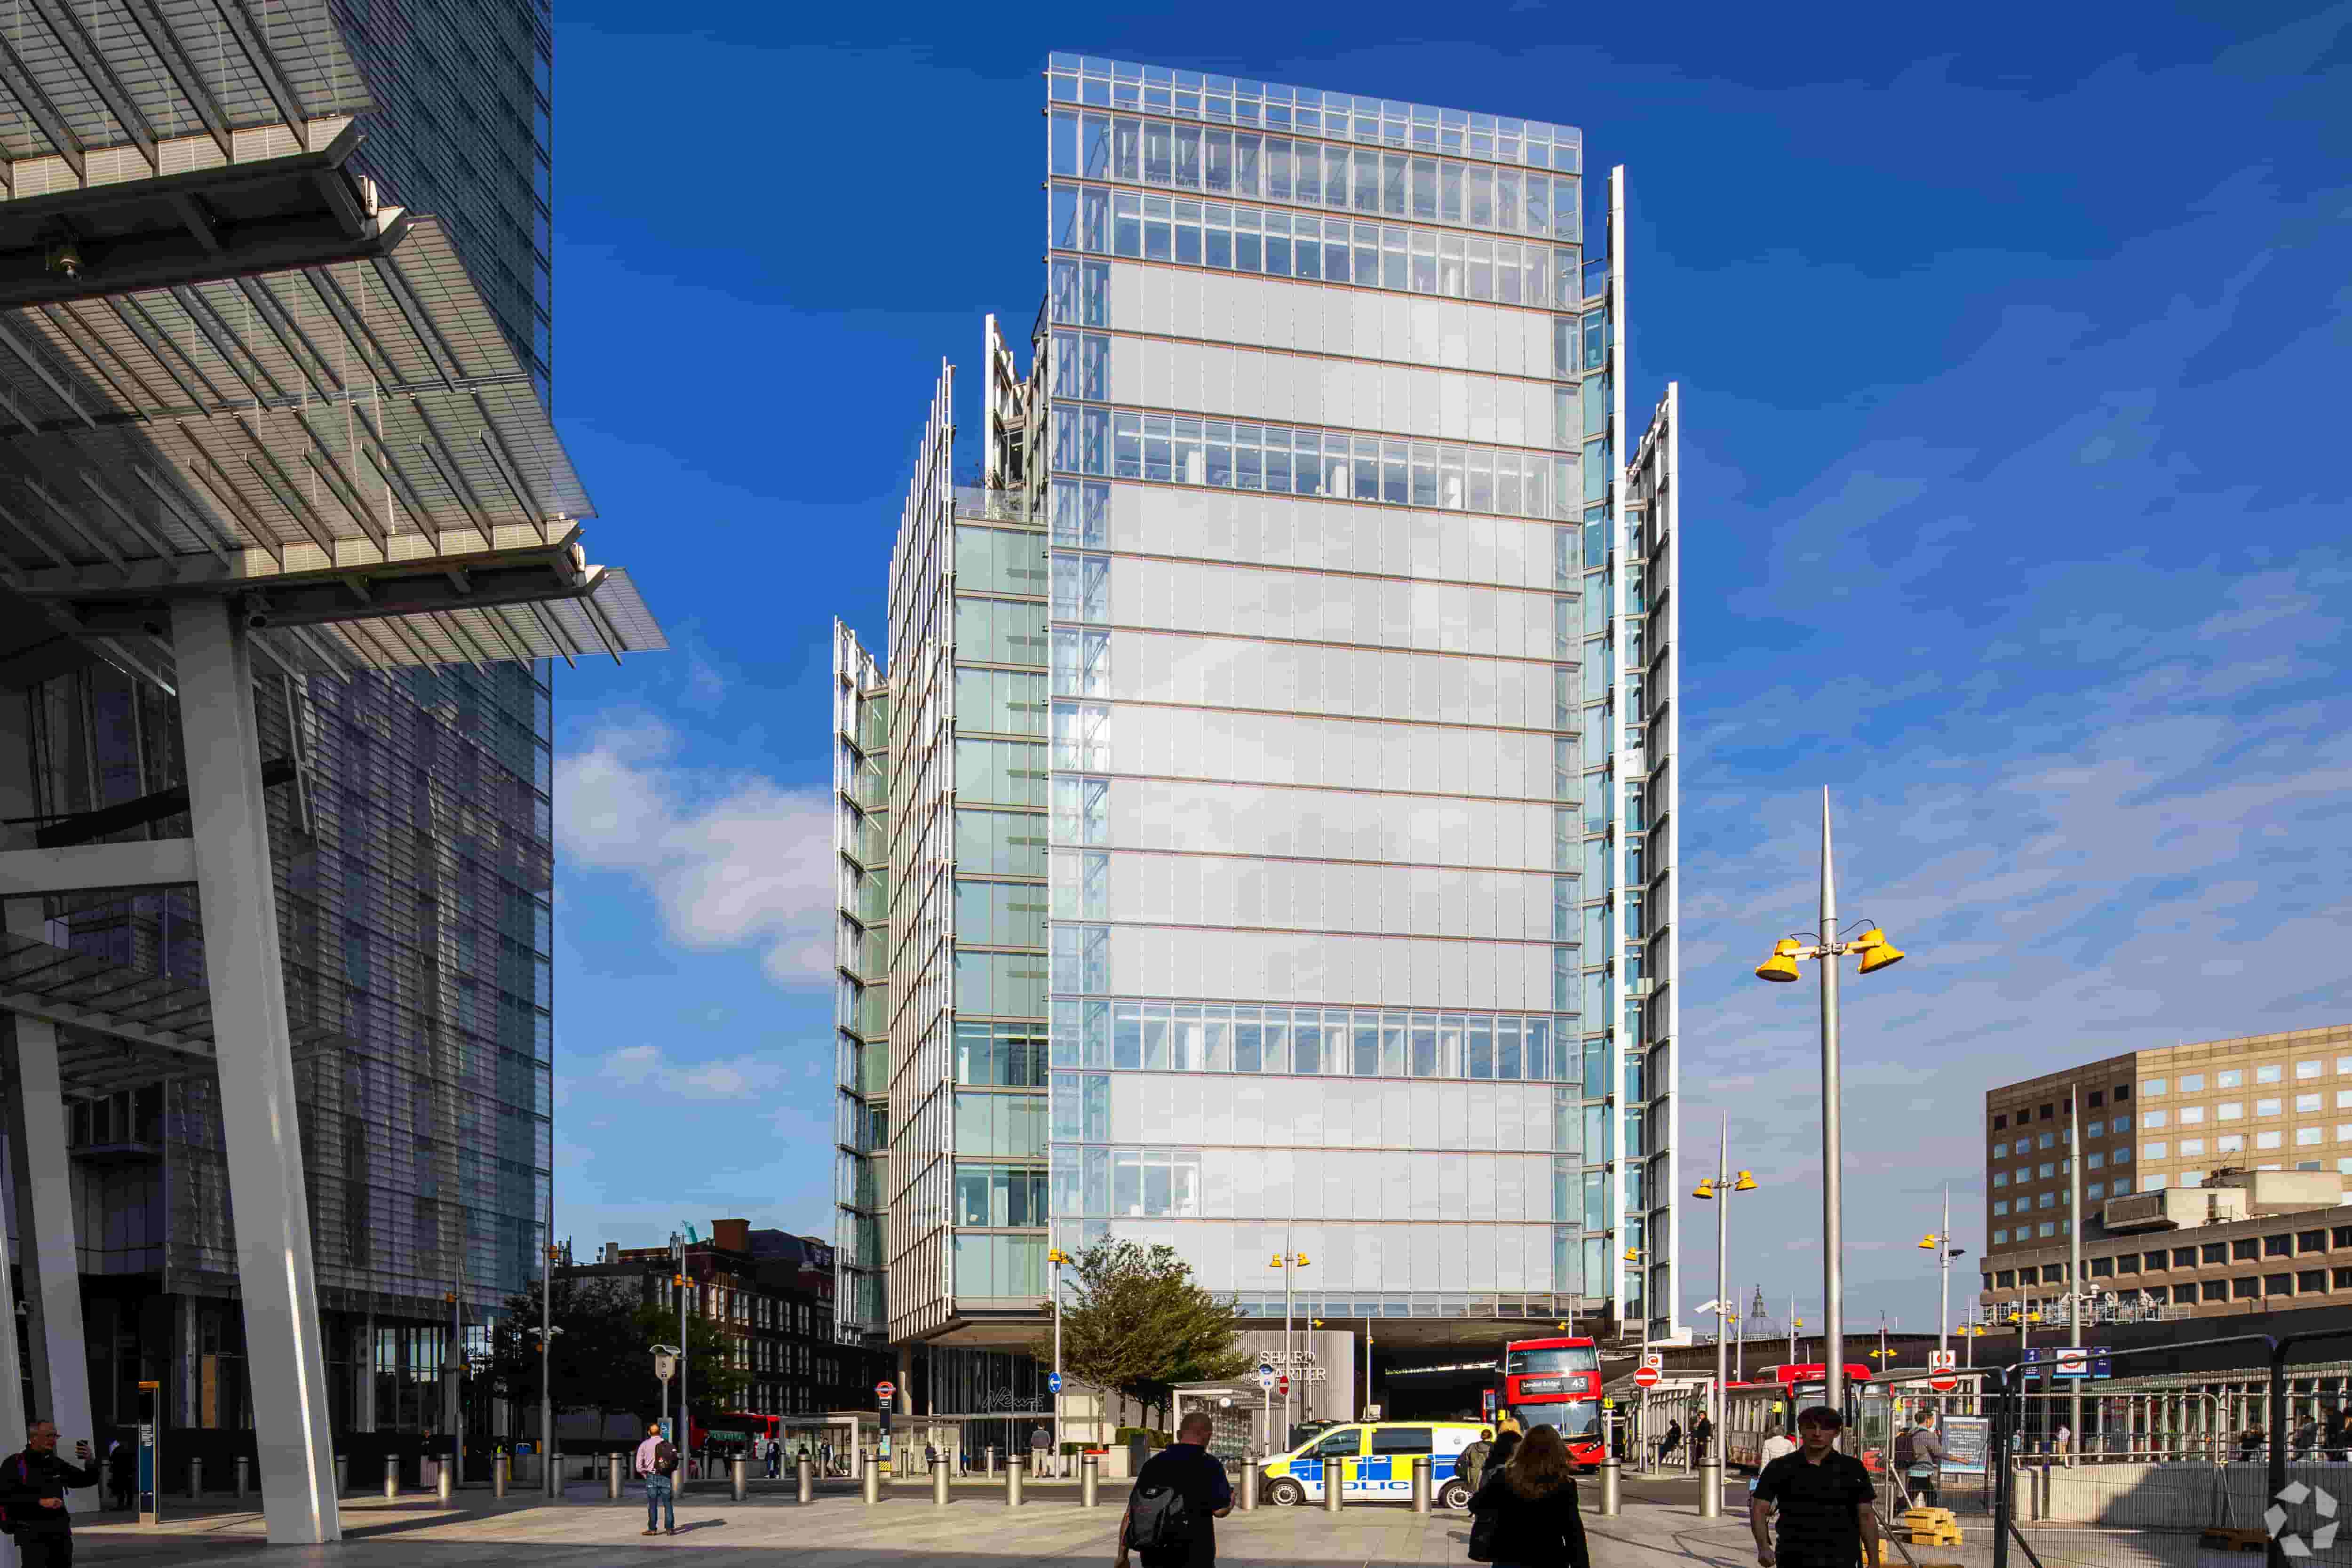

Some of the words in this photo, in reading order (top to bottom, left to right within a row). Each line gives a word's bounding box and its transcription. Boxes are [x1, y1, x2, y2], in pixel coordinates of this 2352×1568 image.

[1259, 1351, 1315, 1364] SHARD
[1249, 1367, 1326, 1381] QARTER
[1572, 1377, 1585, 1388] 43
